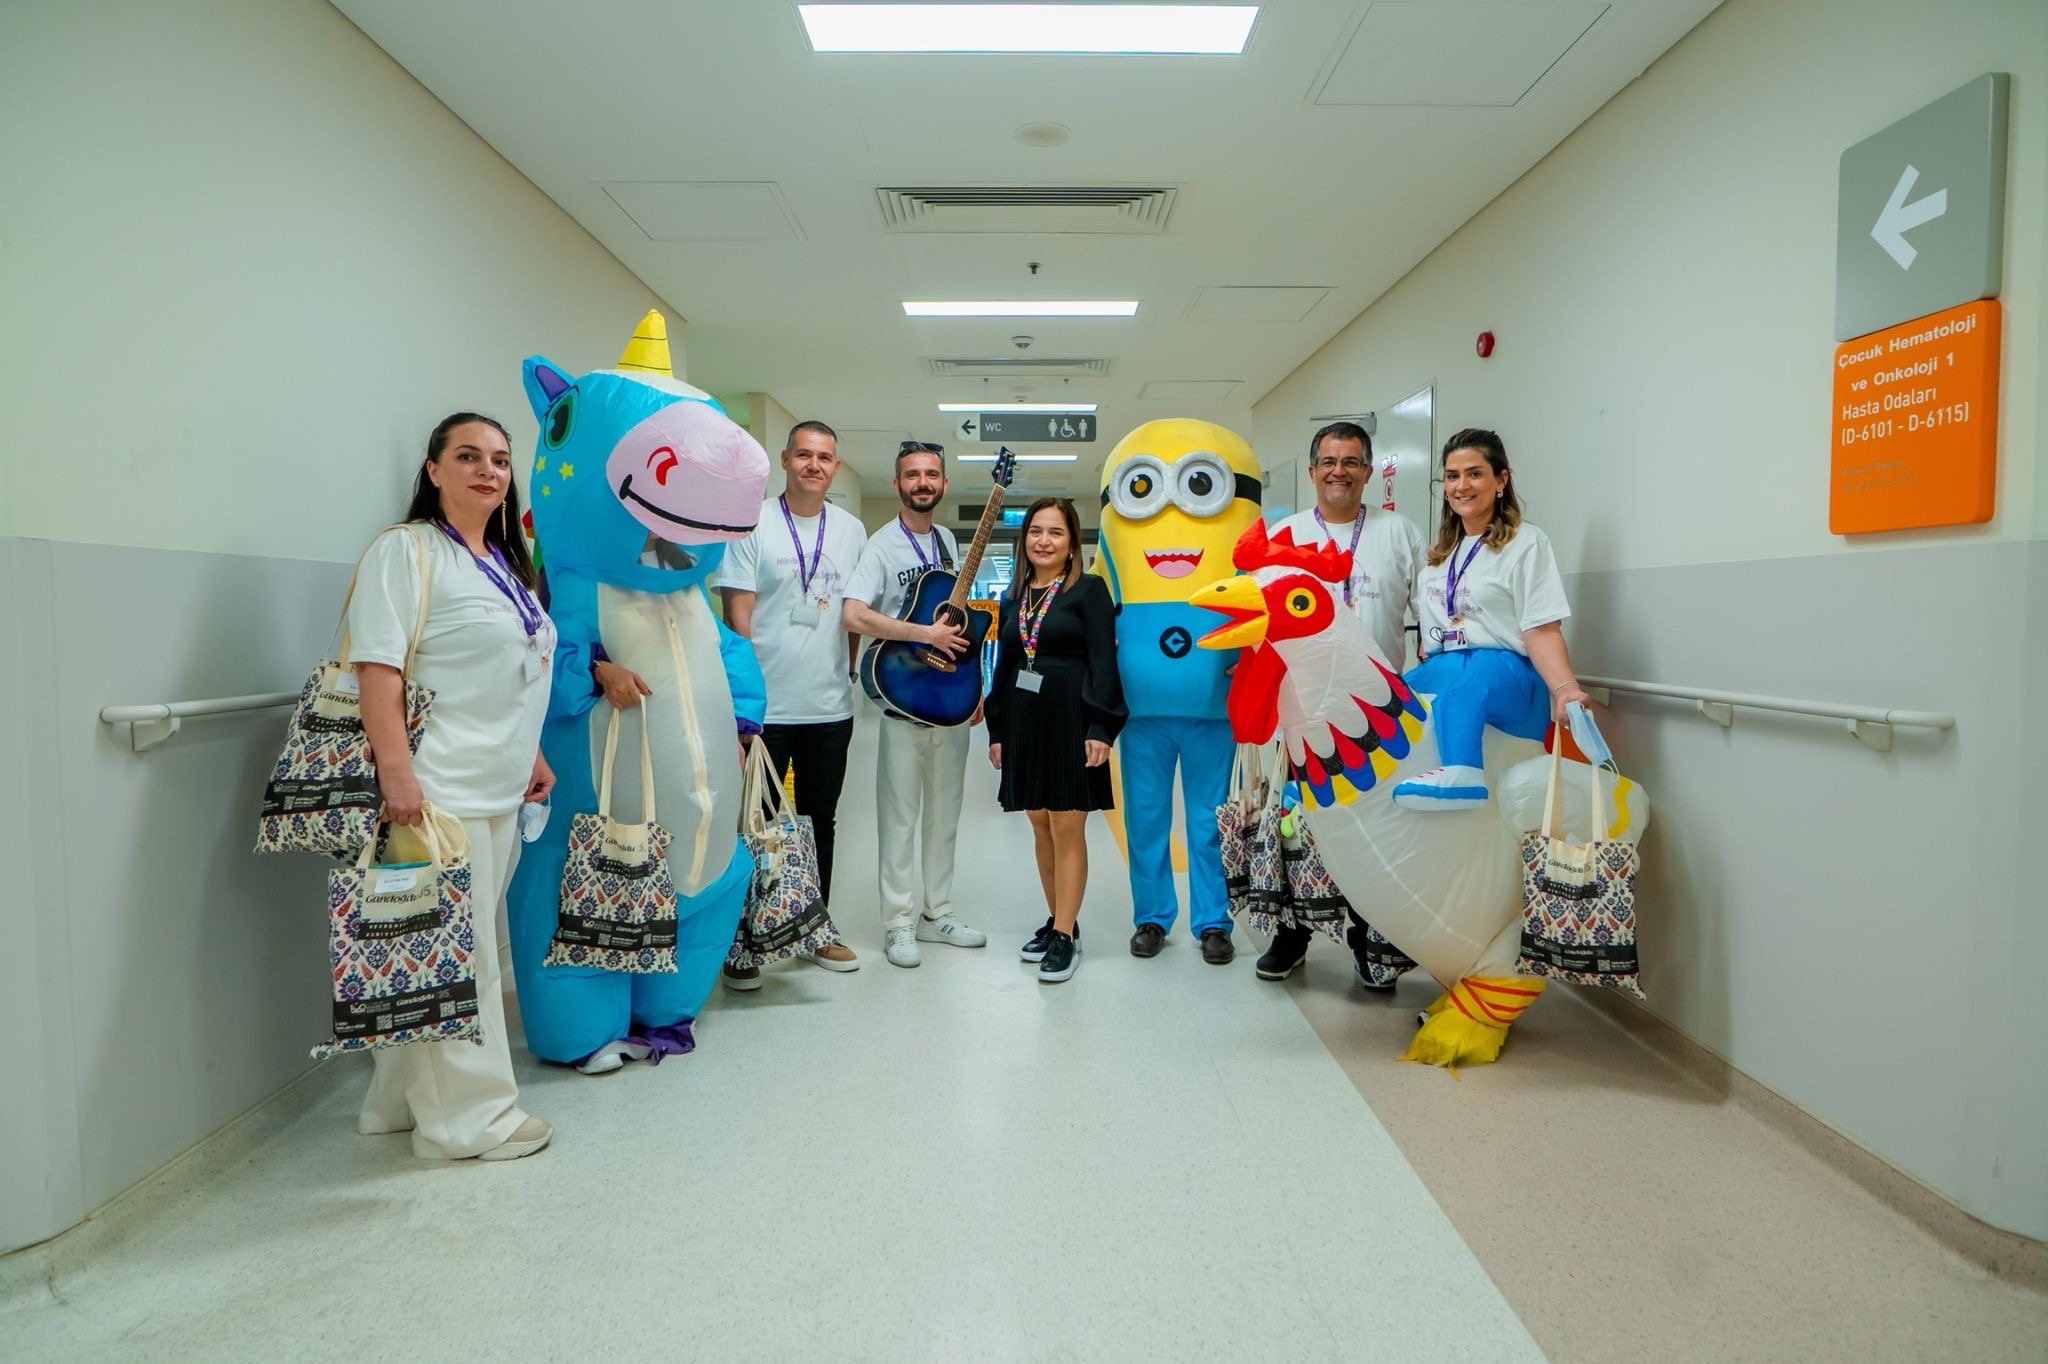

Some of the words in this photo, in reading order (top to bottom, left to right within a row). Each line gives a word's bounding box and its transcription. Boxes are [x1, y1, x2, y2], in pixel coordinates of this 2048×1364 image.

[1838, 344, 1883, 369] Çocuk
[1889, 313, 1977, 353] Hematoloji
[1851, 378, 1868, 393] ve
[1873, 357, 1938, 386] Onkoloji
[1946, 352, 1954, 367] 1
[1841, 419, 1893, 446] (D-6101
[1908, 402, 1969, 432] D-6115)
[1842, 400, 1880, 421] Hasta
[1884, 387, 1937, 409] Odaları
[984, 422, 1002, 432] WC
